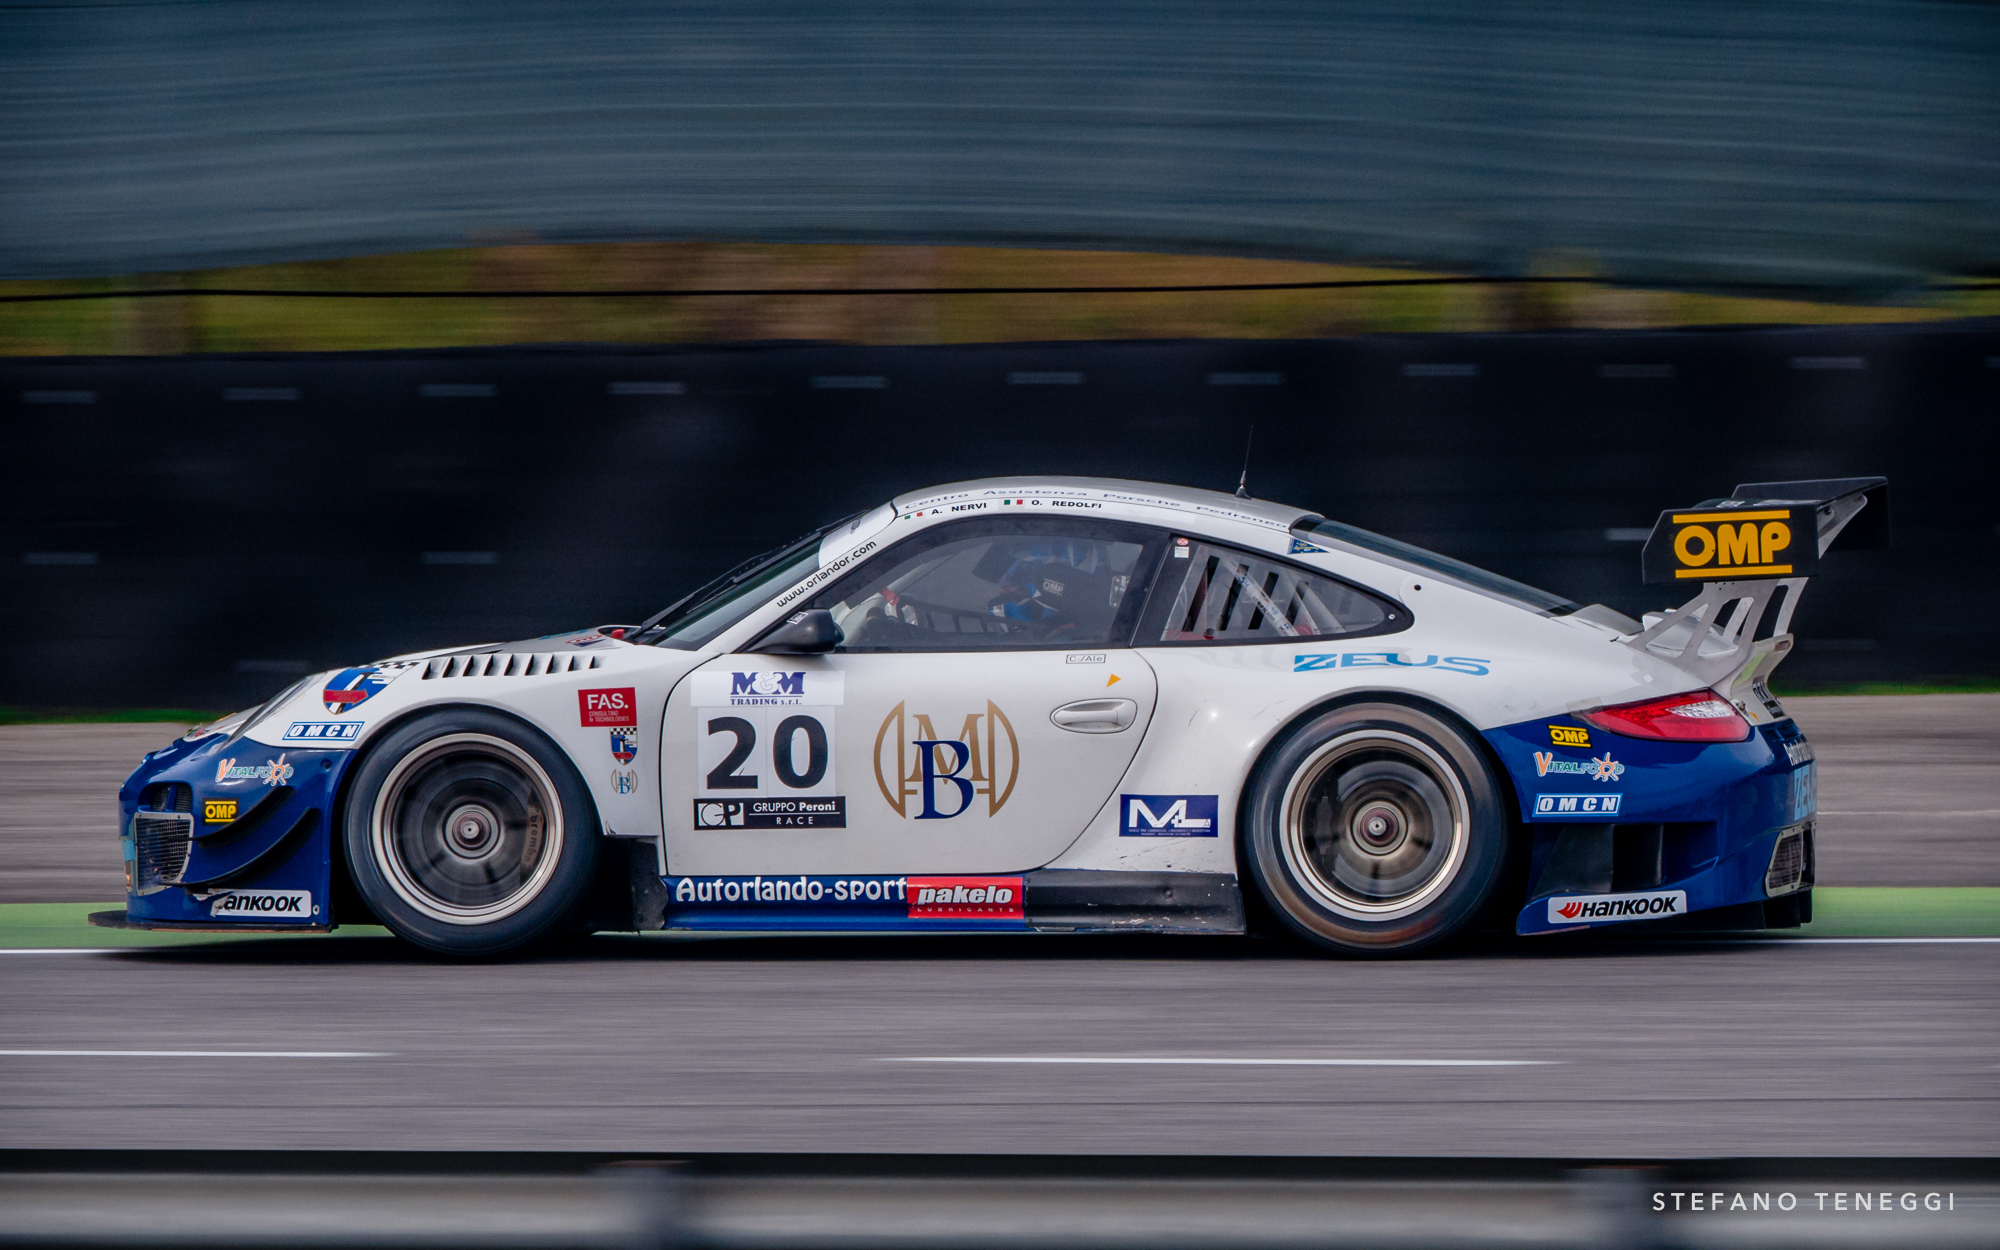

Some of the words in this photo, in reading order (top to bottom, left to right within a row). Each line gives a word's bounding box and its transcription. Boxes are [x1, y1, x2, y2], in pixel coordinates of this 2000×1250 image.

[904, 493, 969, 509] Centro
[1103, 493, 1181, 507] Porsche
[951, 502, 988, 512] NERVI
[1052, 500, 1102, 509] REDOLFI
[1673, 521, 1792, 567] OMP
[776, 541, 878, 608] www.orlandor.com
[1042, 581, 1065, 593] OMP
[1293, 652, 1492, 676] ZEUS
[730, 672, 807, 695] M&M
[587, 693, 629, 710] FAS.
[730, 698, 778, 706] TRADING
[289, 725, 358, 737] OMCN
[1550, 729, 1589, 743] OMP
[706, 714, 829, 790] 20
[204, 804, 237, 819] OMP
[752, 802, 796, 813] GRUPPO
[799, 801, 836, 811] Peroni
[1539, 797, 1617, 811] OMCN
[776, 816, 814, 825] RACE
[676, 876, 908, 901] Autorlando-sport
[917, 884, 1013, 905] pakelo
